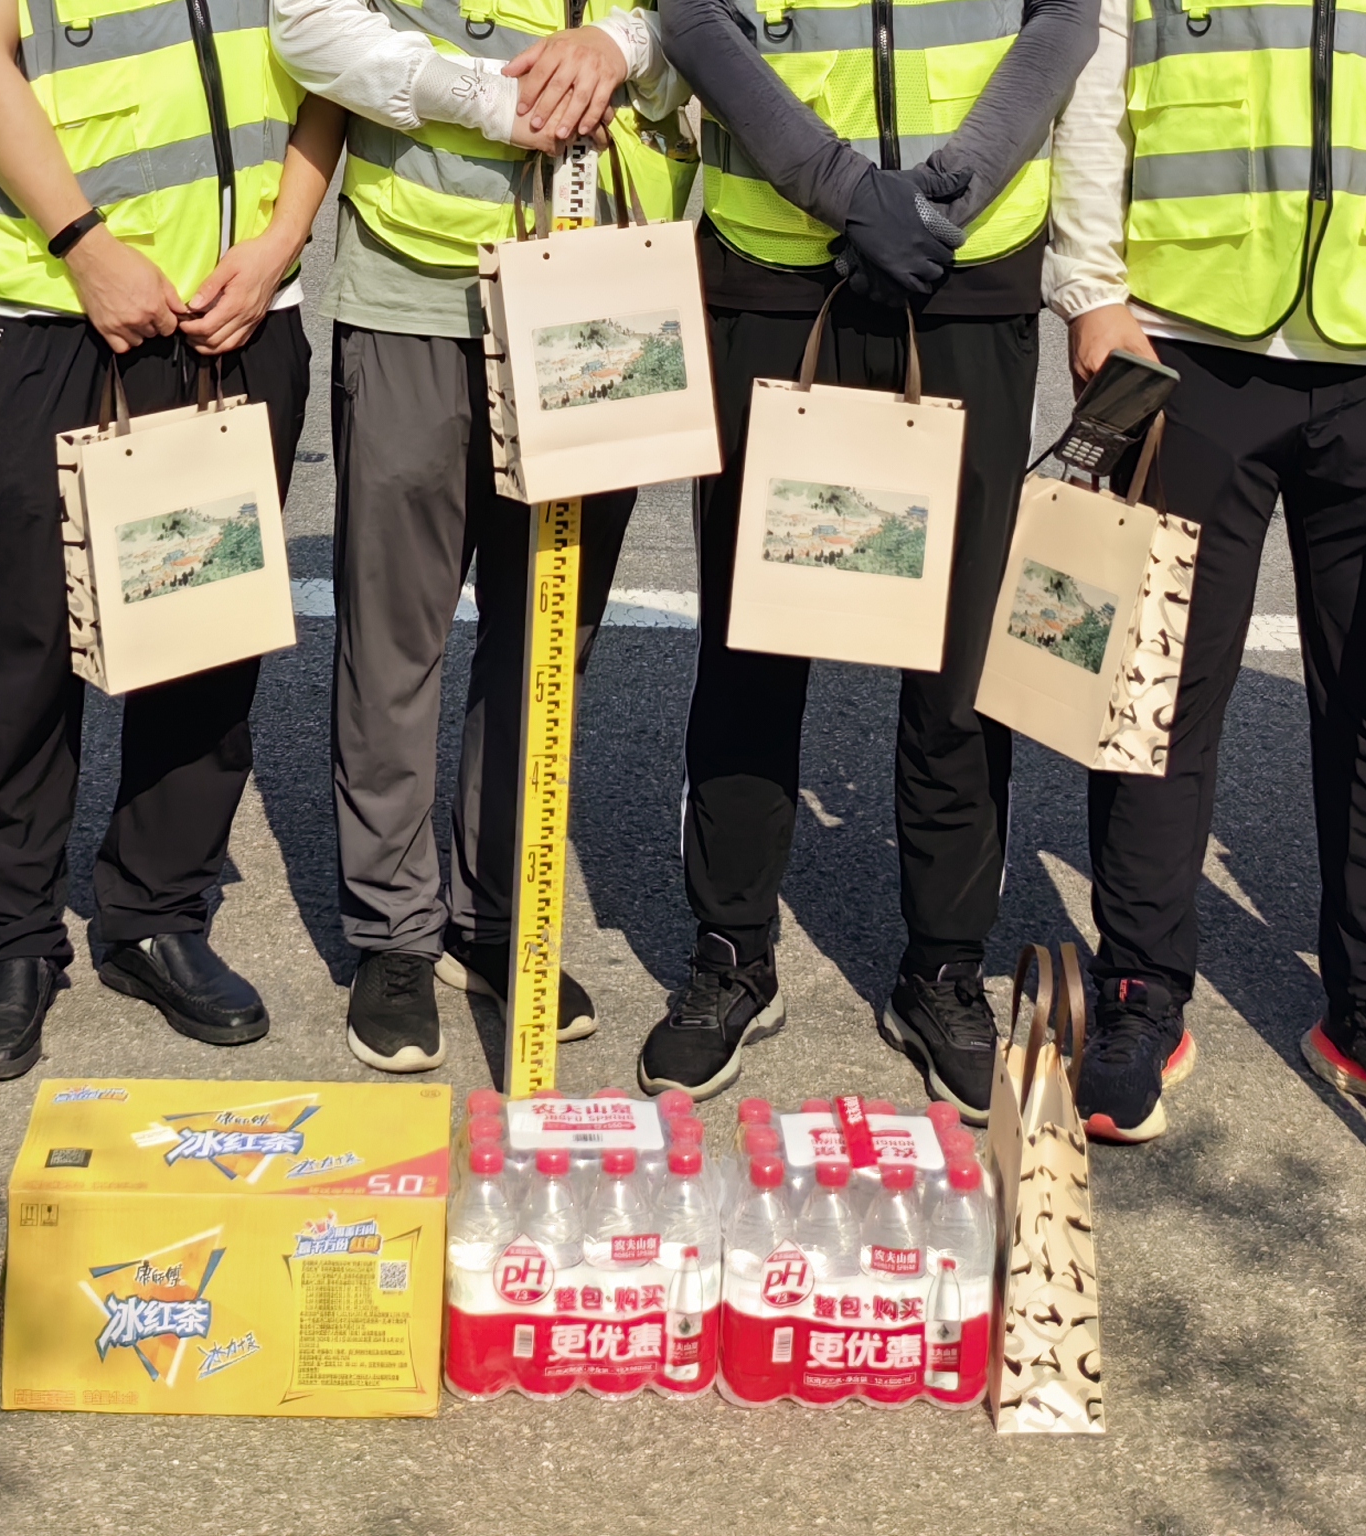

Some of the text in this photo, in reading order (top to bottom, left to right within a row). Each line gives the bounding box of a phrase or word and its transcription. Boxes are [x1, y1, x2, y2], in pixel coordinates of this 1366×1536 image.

[540, 581, 549, 613] 6
[535, 670, 545, 703] 5
[527, 851, 536, 883] 3
[519, 1031, 527, 1063] 1
[532, 1102, 632, 1114] 农夫山泉
[170, 1127, 301, 1162] 冰红茶
[614, 1237, 657, 1251] 农夫山泉
[875, 1249, 917, 1264] 农夫山泉
[501, 1258, 546, 1292] pH
[764, 1262, 807, 1294] pH
[97, 1295, 208, 1353] 冰红茶
[548, 1322, 664, 1362] 更优惠
[806, 1330, 922, 1369] 更优惠
